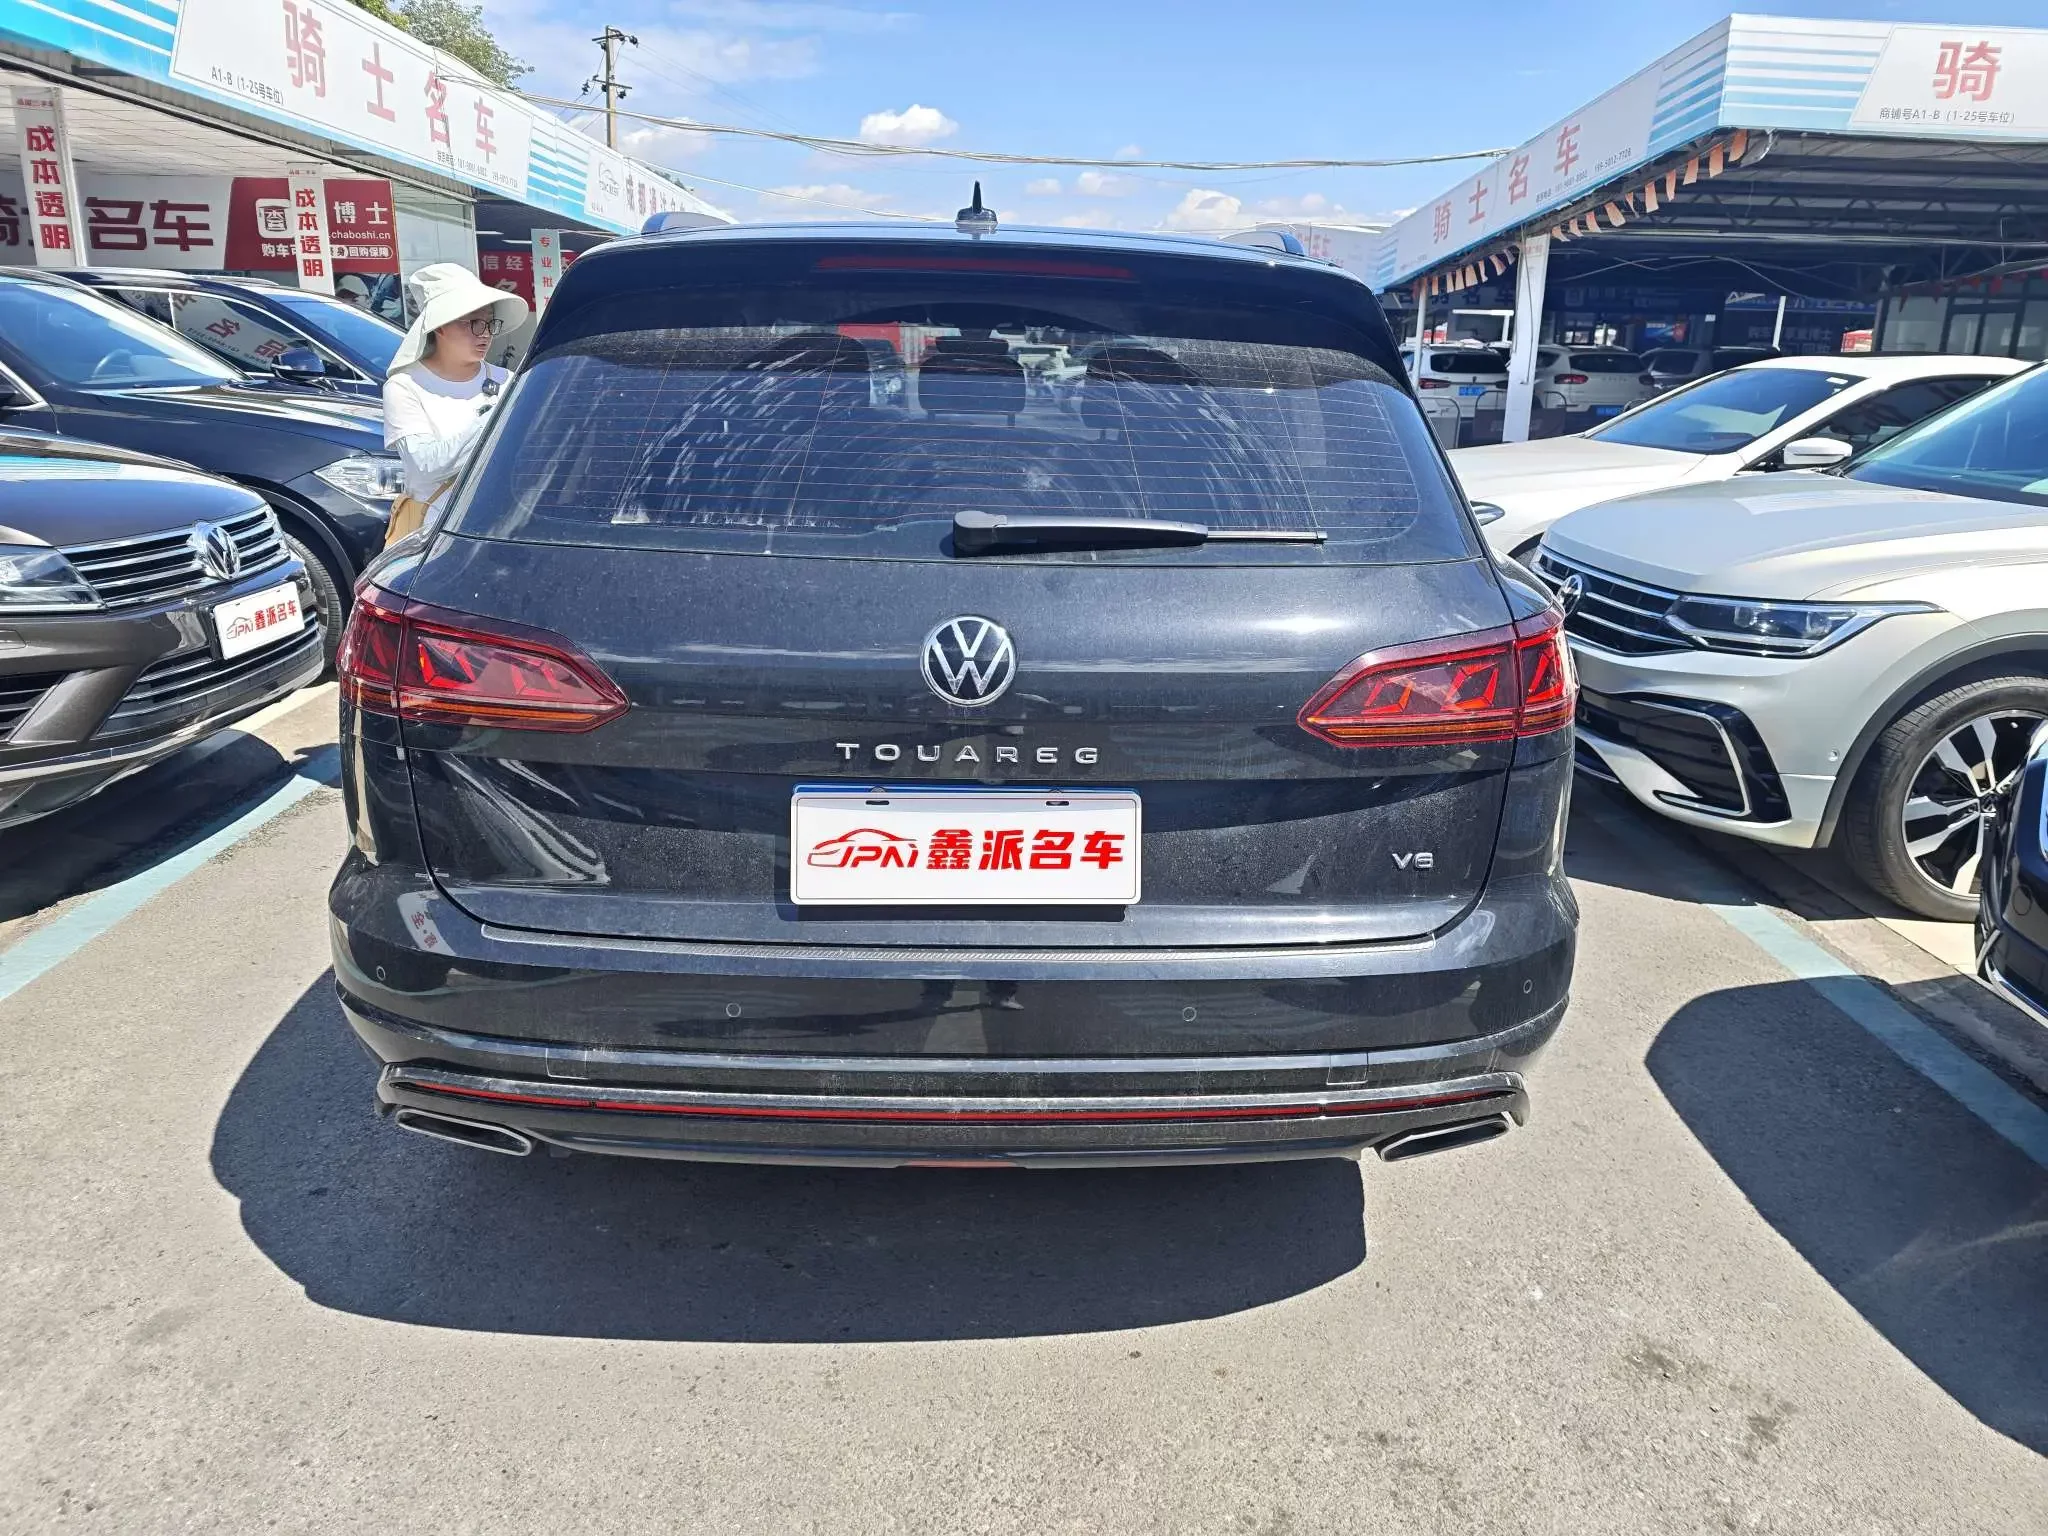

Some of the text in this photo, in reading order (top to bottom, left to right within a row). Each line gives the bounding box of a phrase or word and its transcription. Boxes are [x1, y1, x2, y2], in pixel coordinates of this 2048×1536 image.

[283, 0, 497, 164] 骑士名车
[1932, 40, 2003, 102] 骑
[25, 125, 71, 249] 成本透明
[1432, 123, 1581, 243] 骑士名车
[295, 188, 324, 277] 成本透明
[482, 255, 534, 272] 信经
[254, 599, 298, 631] 鑫派名车
[836, 742, 1099, 765] TOUAREG
[926, 829, 1126, 870] 鑫派名车
[1391, 851, 1434, 870] V6
